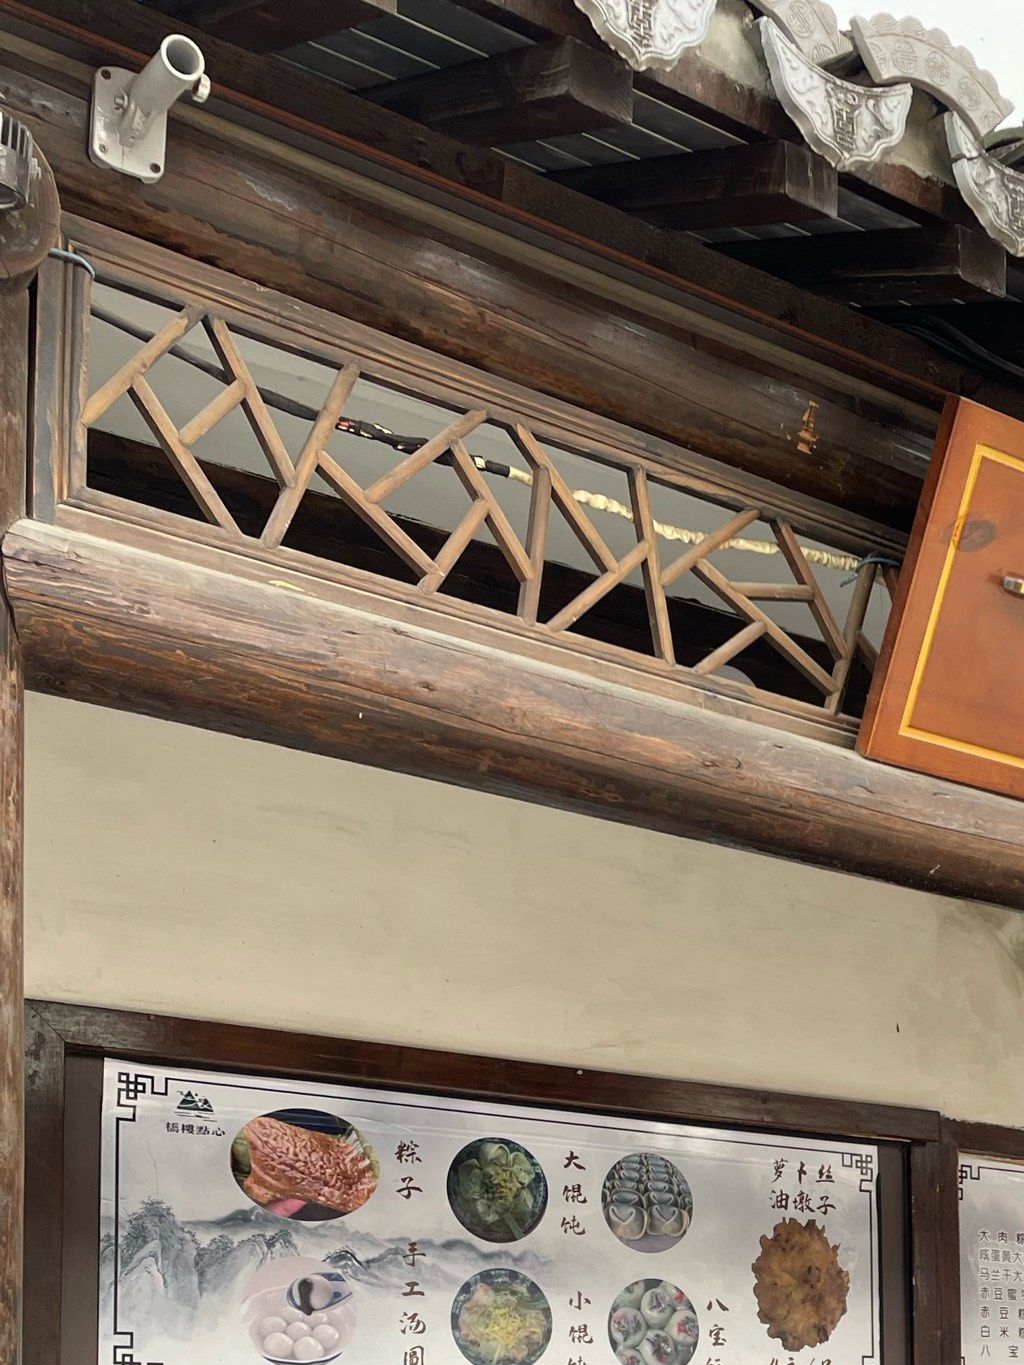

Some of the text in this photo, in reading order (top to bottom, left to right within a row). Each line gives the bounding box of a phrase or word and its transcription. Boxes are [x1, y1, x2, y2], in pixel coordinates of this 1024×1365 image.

[395, 1140, 423, 1198] 粽子
[771, 1158, 836, 1185] 萝卜丝
[561, 1150, 588, 1235] 大馄饨
[769, 1189, 836, 1216] 油墩子
